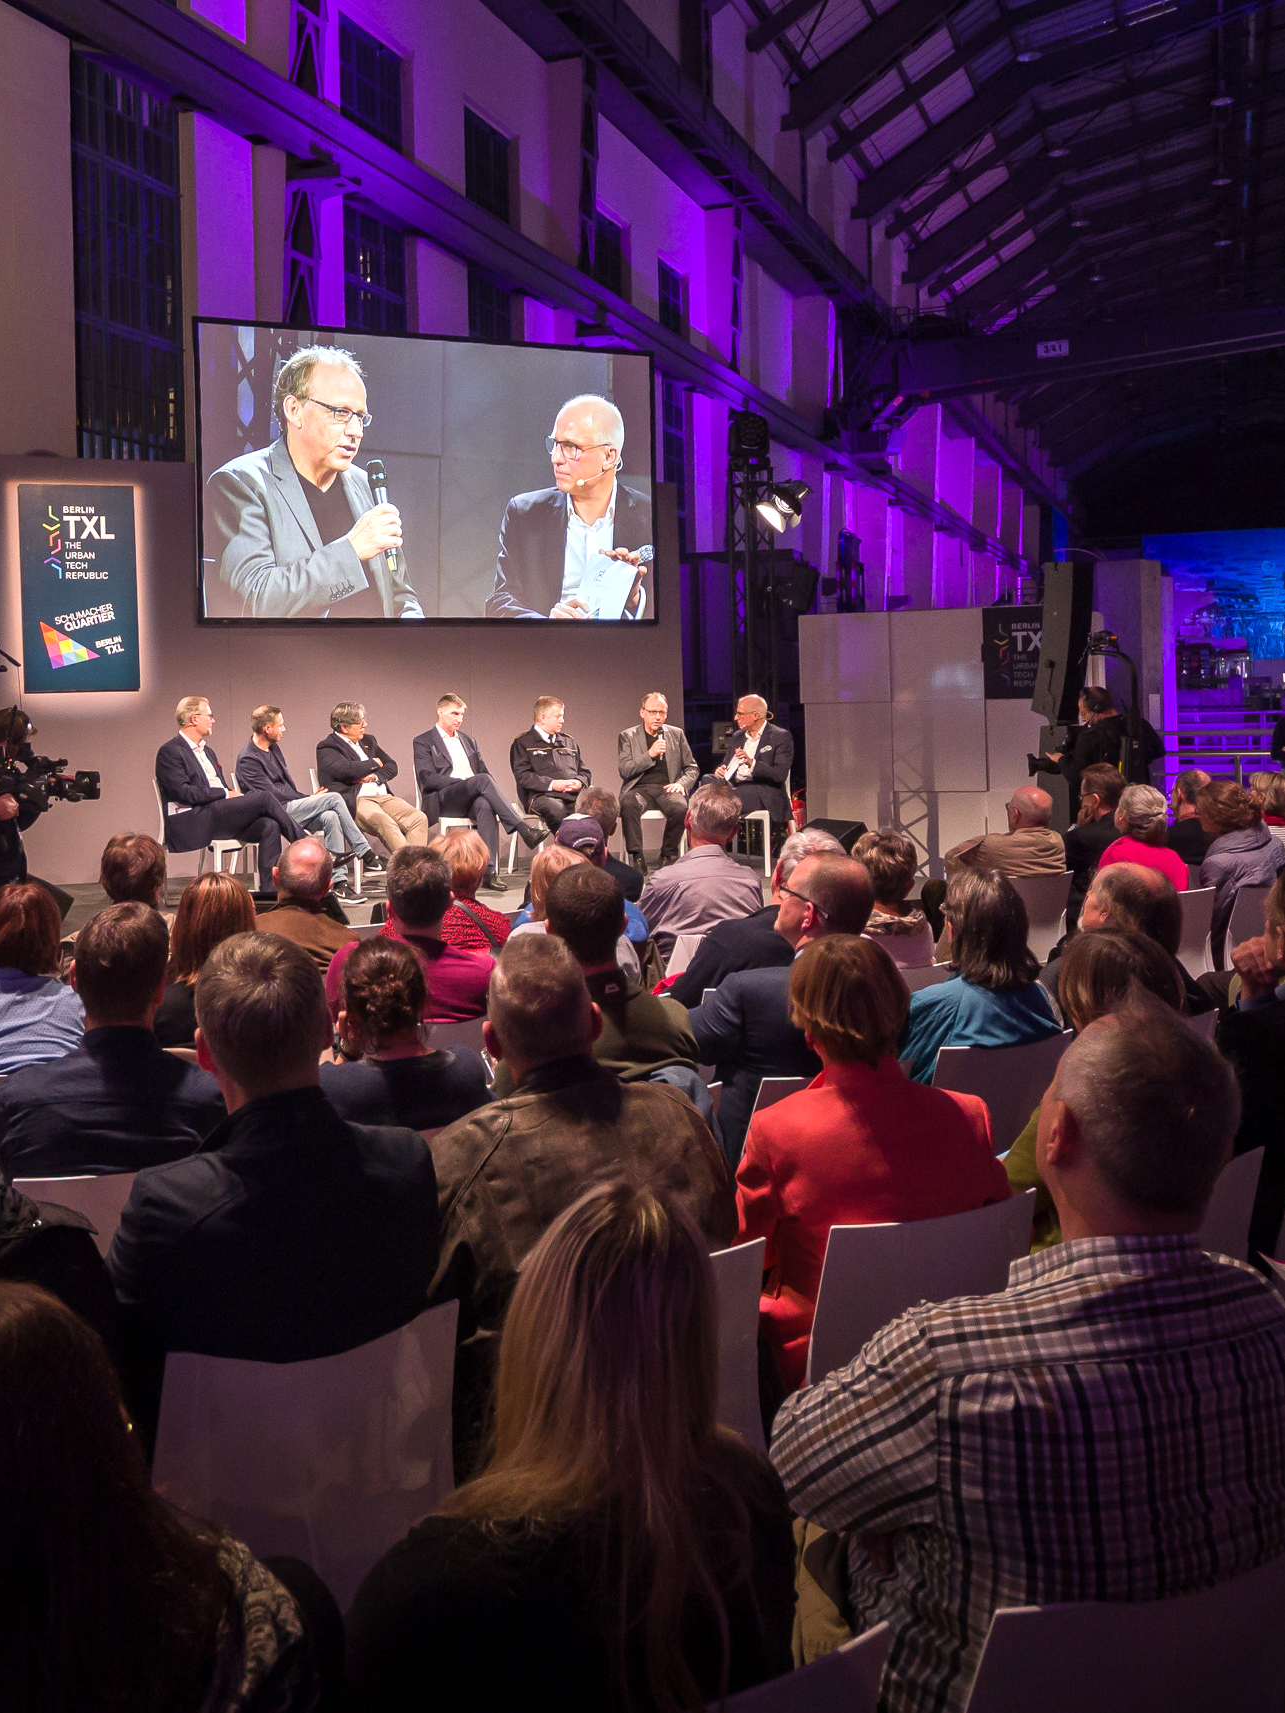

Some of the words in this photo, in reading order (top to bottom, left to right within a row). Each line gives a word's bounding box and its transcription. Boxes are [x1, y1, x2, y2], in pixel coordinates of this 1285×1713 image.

[62, 505, 95, 514] BERLIN
[62, 515, 115, 540] TXL
[64, 541, 82, 550] THE
[64, 551, 95, 560] URBAN
[65, 561, 88, 570] TECH
[65, 571, 109, 580] REPUBLIC
[54, 603, 113, 625] SCHUMACHER
[64, 611, 116, 632] QUARTIER
[1011, 622, 1041, 630] BERLIN
[95, 635, 122, 649] BERLIN
[1011, 631, 1043, 652] TX
[104, 643, 125, 655] TXL
